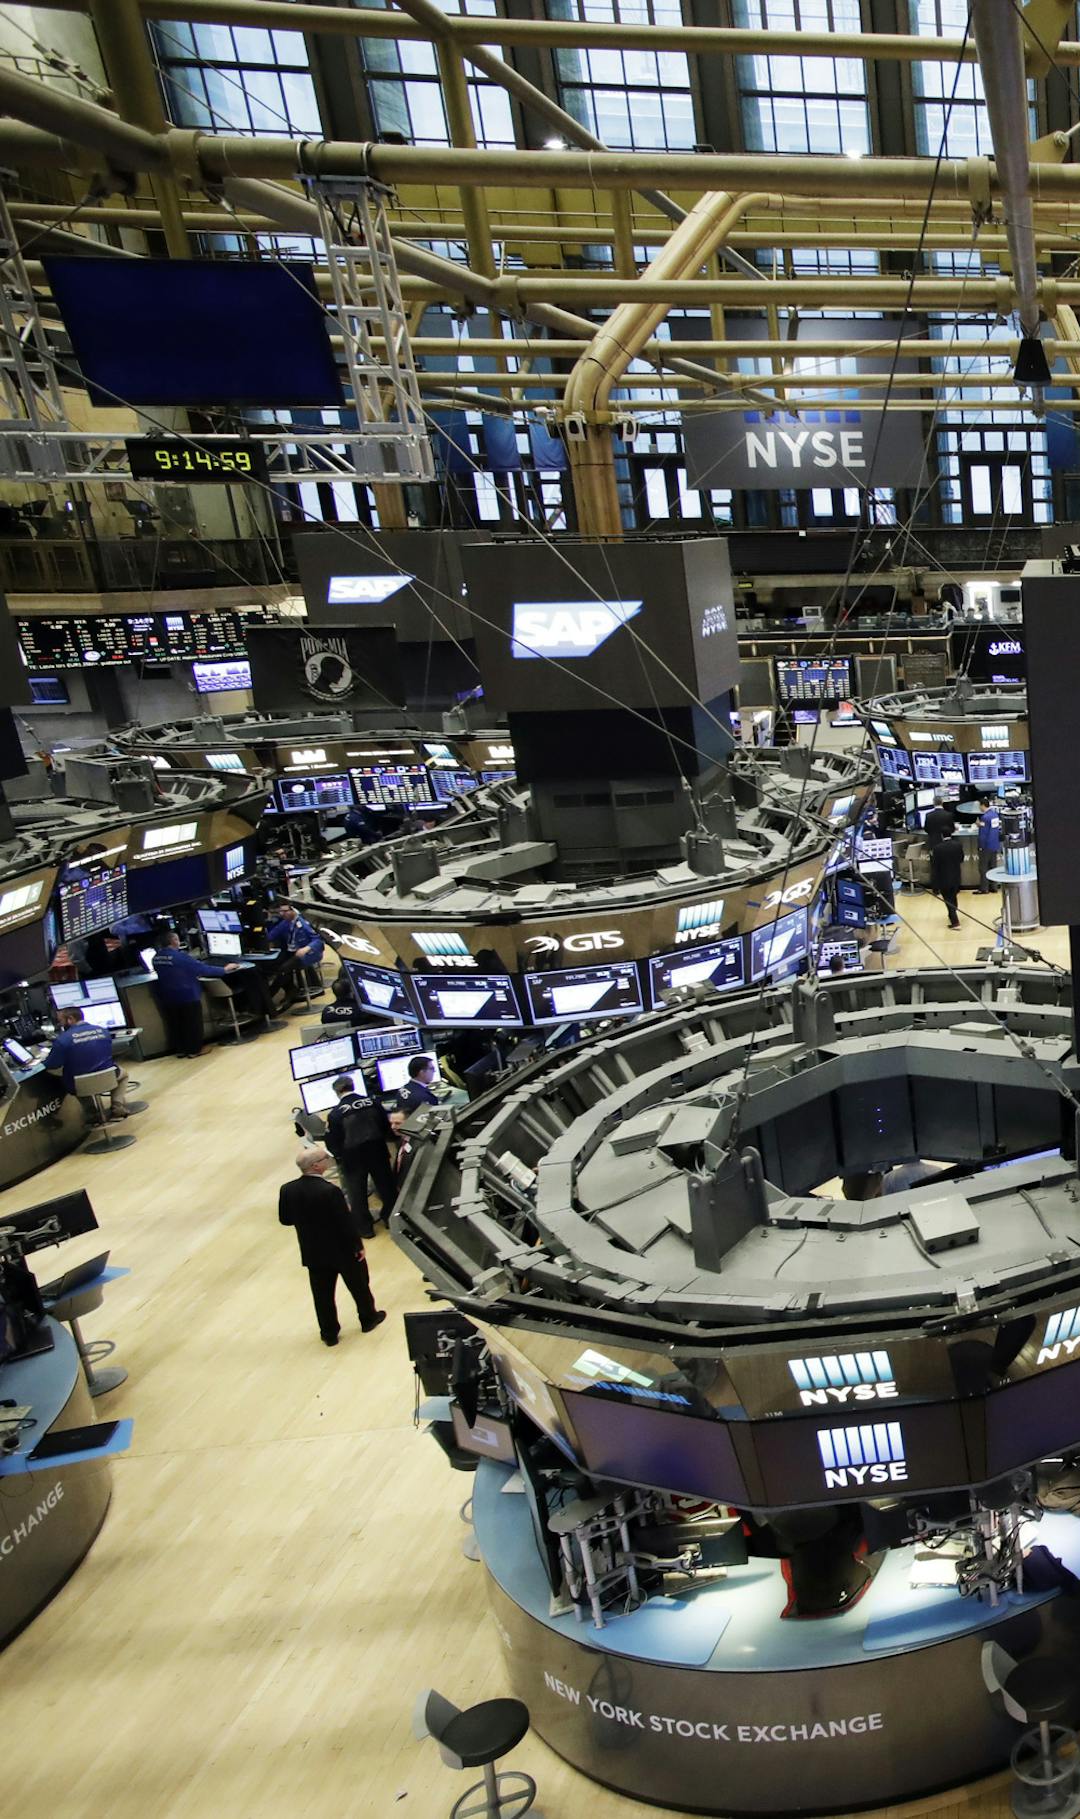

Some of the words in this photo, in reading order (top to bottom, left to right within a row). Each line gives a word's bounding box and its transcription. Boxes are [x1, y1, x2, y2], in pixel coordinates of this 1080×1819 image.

[745, 431, 866, 468] NYSE
[155, 450, 252, 471] 9:14:59
[331, 579, 396, 598] SAP
[514, 610, 613, 647] SAP
[702, 621, 729, 638] NYSE
[933, 733, 955, 742] imc
[226, 865, 245, 881] NYSE
[563, 930, 625, 951] GTS
[675, 922, 721, 944] NYSE
[426, 954, 479, 967] NYSE
[335, 1006, 353, 1015] GTS
[351, 1097, 374, 1109] GTS
[4, 1097, 61, 1136] EXCHANGE
[800, 1381, 899, 1407] NYSE
[825, 1461, 909, 1489] NYSE
[0, 1481, 65, 1560] CHANGE
[544, 1671, 581, 1706] NEW
[586, 1695, 644, 1729] YORK
[649, 1715, 730, 1742] STOCK
[737, 1712, 884, 1743] EXCHANGE
